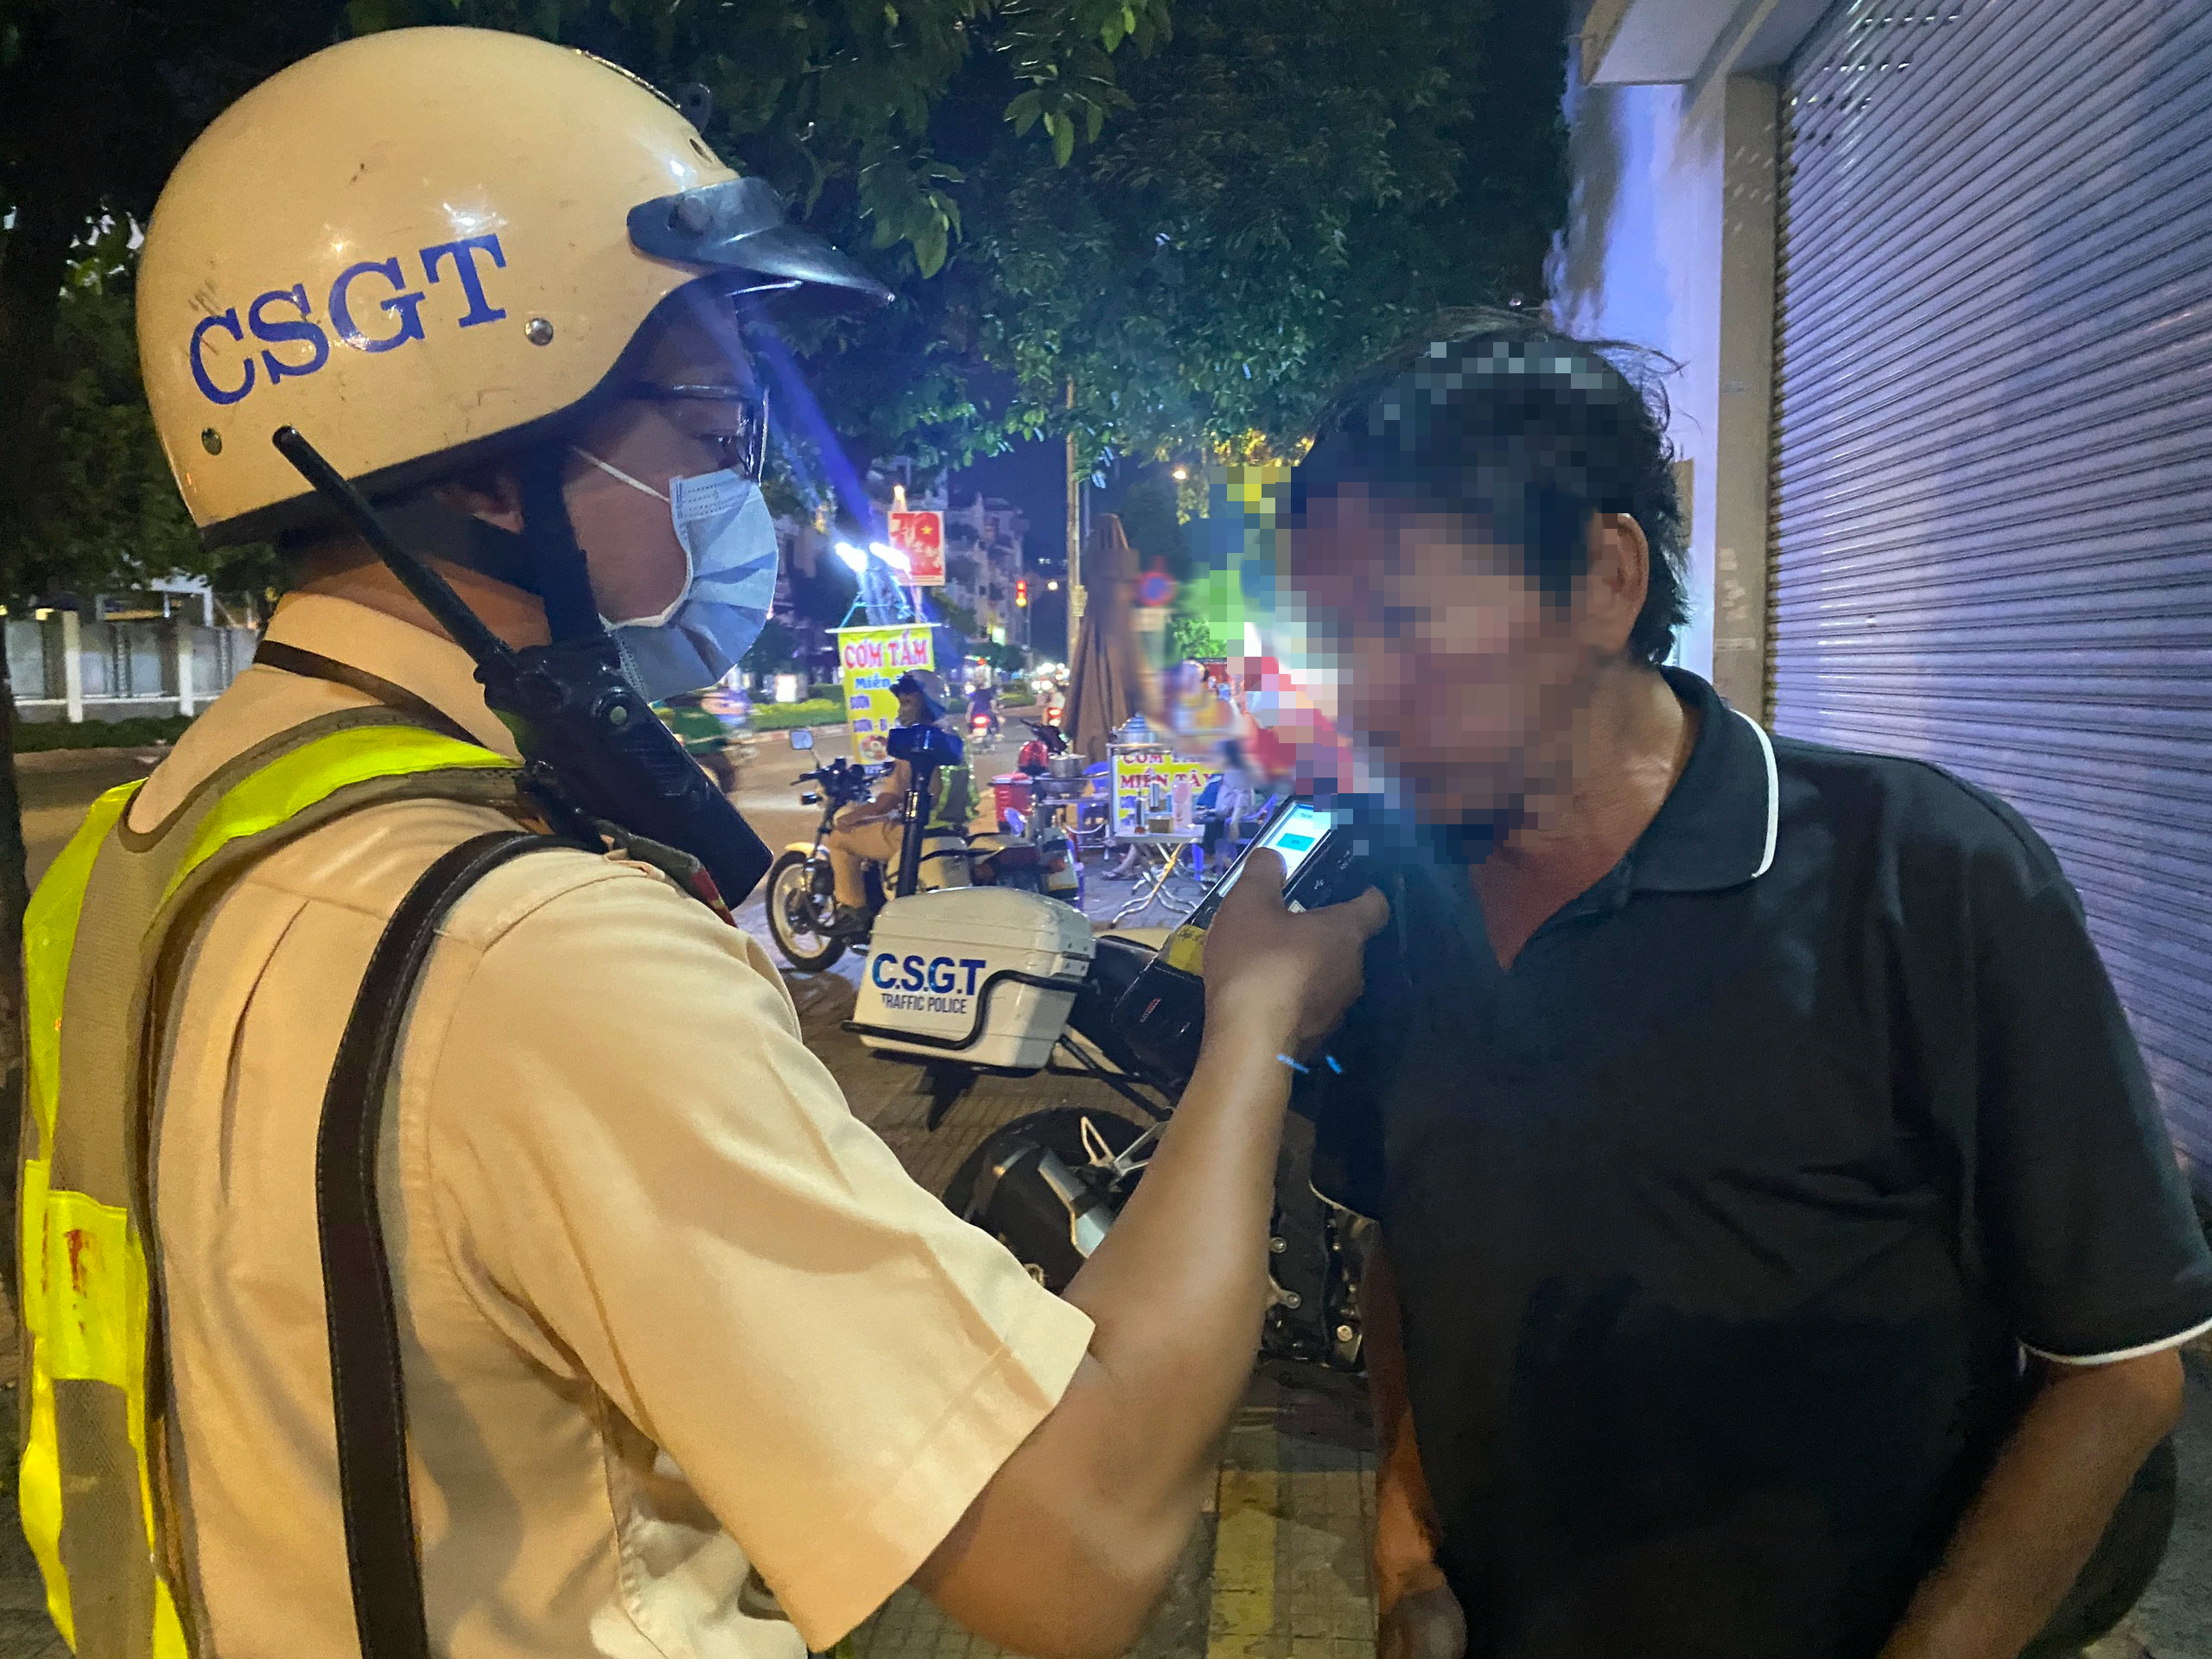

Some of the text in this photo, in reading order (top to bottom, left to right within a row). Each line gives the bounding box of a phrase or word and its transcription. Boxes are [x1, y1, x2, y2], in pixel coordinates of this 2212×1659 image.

[189, 233, 507, 405] CSGT
[872, 952, 986, 996] C.S.G.T
[880, 993, 968, 1014] TRAFFIC POLICE
